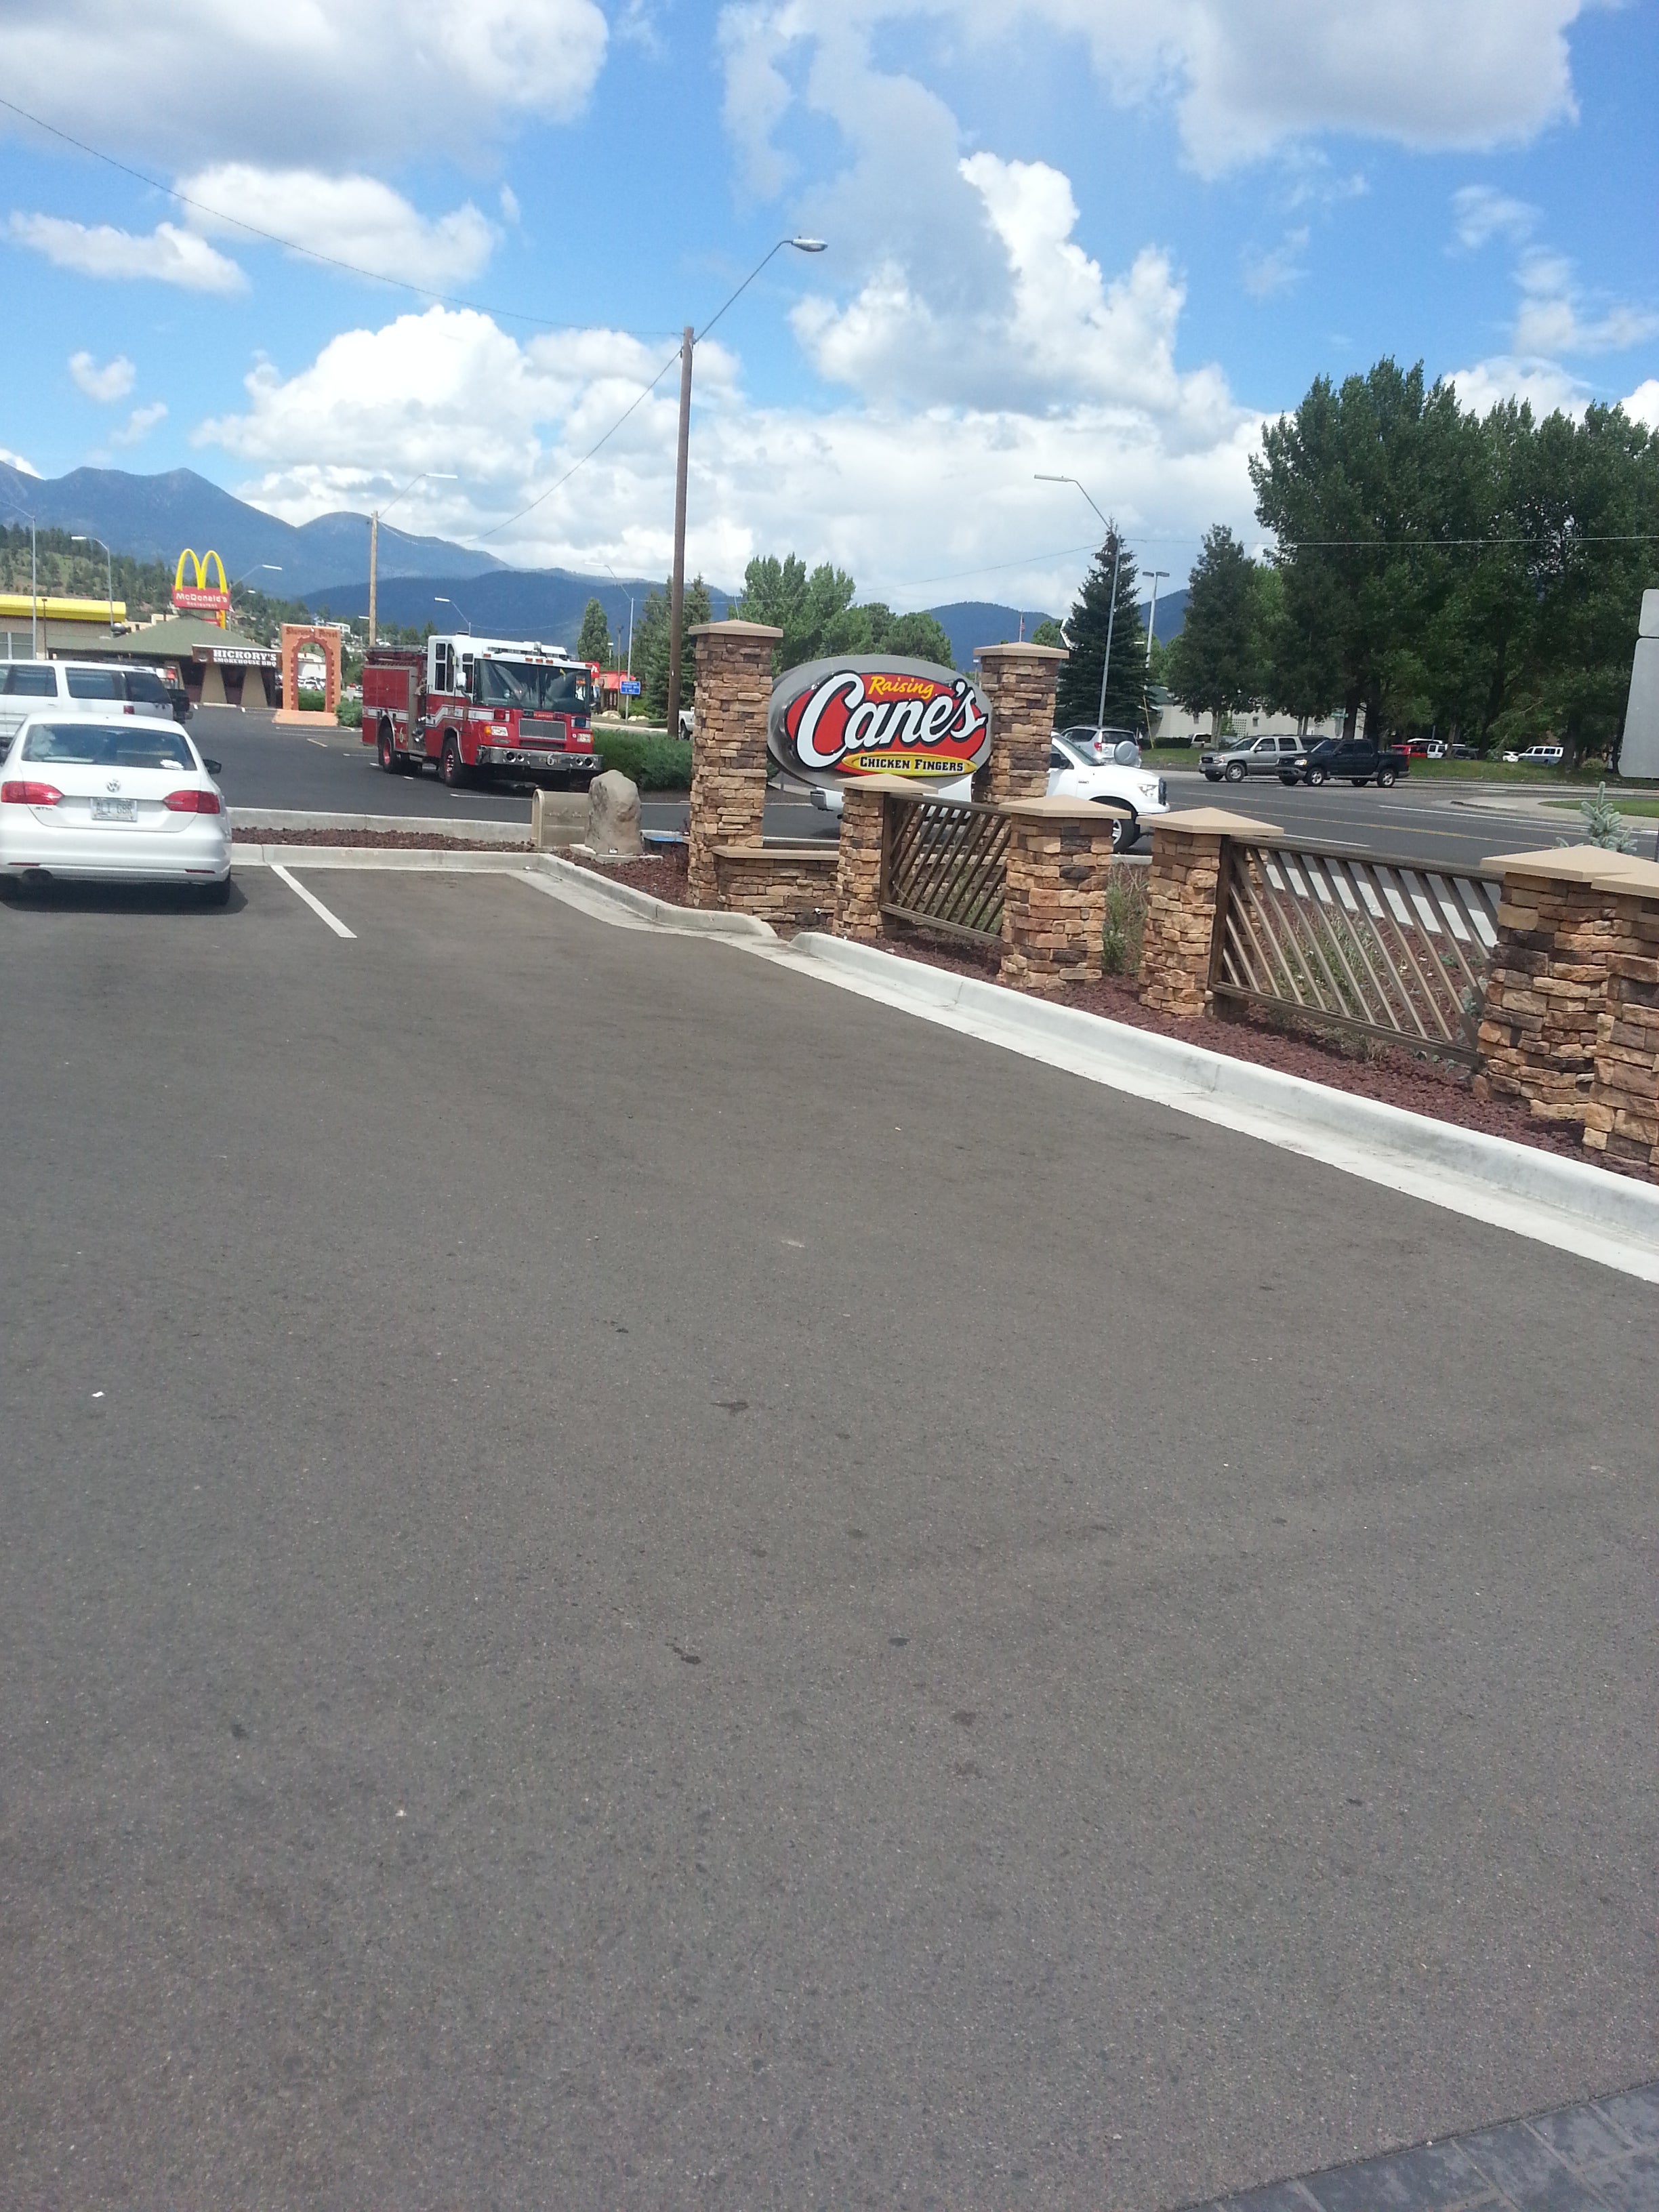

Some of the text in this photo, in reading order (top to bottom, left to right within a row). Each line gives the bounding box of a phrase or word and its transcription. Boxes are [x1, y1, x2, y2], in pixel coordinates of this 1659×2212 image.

[176, 593, 227, 602] McDonald's
[213, 649, 276, 661] HICKORY'S
[213, 657, 276, 668] SMOKEHOUSE BBQ
[868, 676, 935, 700] Raising
[796, 672, 987, 769] Cane's
[399, 726, 405, 743] 6
[546, 753, 555, 766] 6
